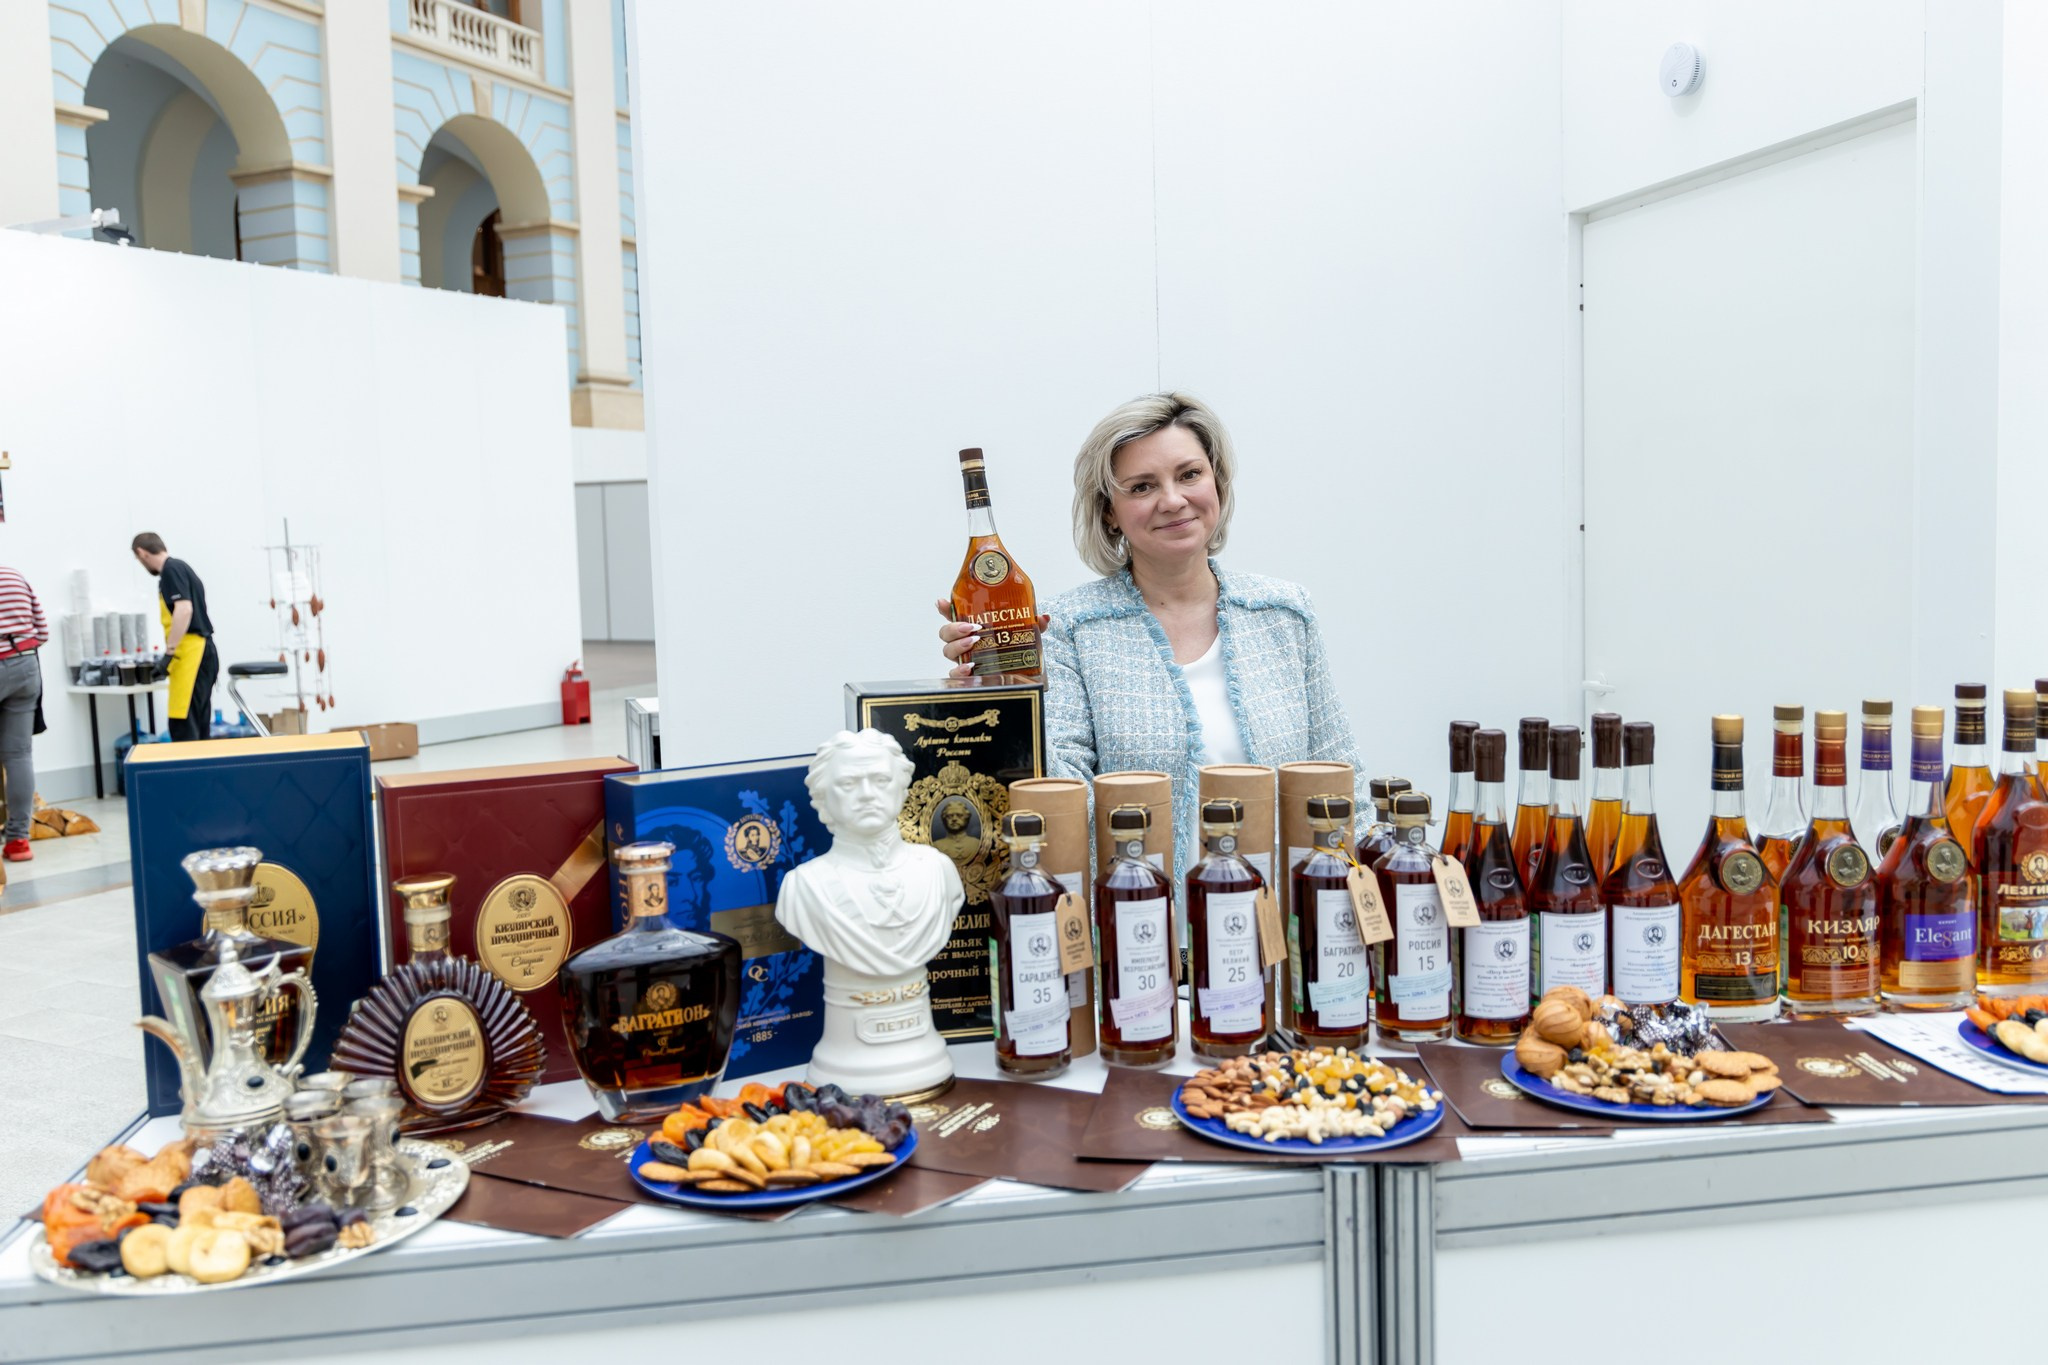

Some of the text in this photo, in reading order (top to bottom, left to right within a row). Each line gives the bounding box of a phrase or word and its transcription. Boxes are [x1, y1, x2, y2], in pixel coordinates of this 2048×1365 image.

[996, 631, 1011, 644] 13
[936, 747, 972, 758] России
[495, 915, 554, 934] КИЗЛЯРСКИЙ
[1697, 921, 1777, 942] ДАГЕСТАН
[1807, 915, 1881, 935] КИЗЛЯР
[491, 925, 560, 945] ПРАЗДНИЧНЫЙ
[1914, 927, 1972, 949] Elegant
[945, 937, 983, 949] оньяк
[1323, 944, 1365, 957] БАГРАТИОН
[1408, 939, 1442, 951] РОССИЯ
[952, 949, 989, 959] выдерж
[1228, 949, 1244, 957] ПЕТР
[1734, 951, 1757, 966] 13
[1842, 944, 1860, 960] 10
[2032, 945, 2043, 960] 6
[1222, 956, 1250, 965] ВЕЛИКИЙ
[1418, 955, 1435, 971] 15
[523, 966, 535, 976] КС
[1228, 966, 1247, 983] 25
[1337, 961, 1355, 978] 20
[1137, 973, 1156, 991] 30
[1032, 986, 1052, 1004] 35
